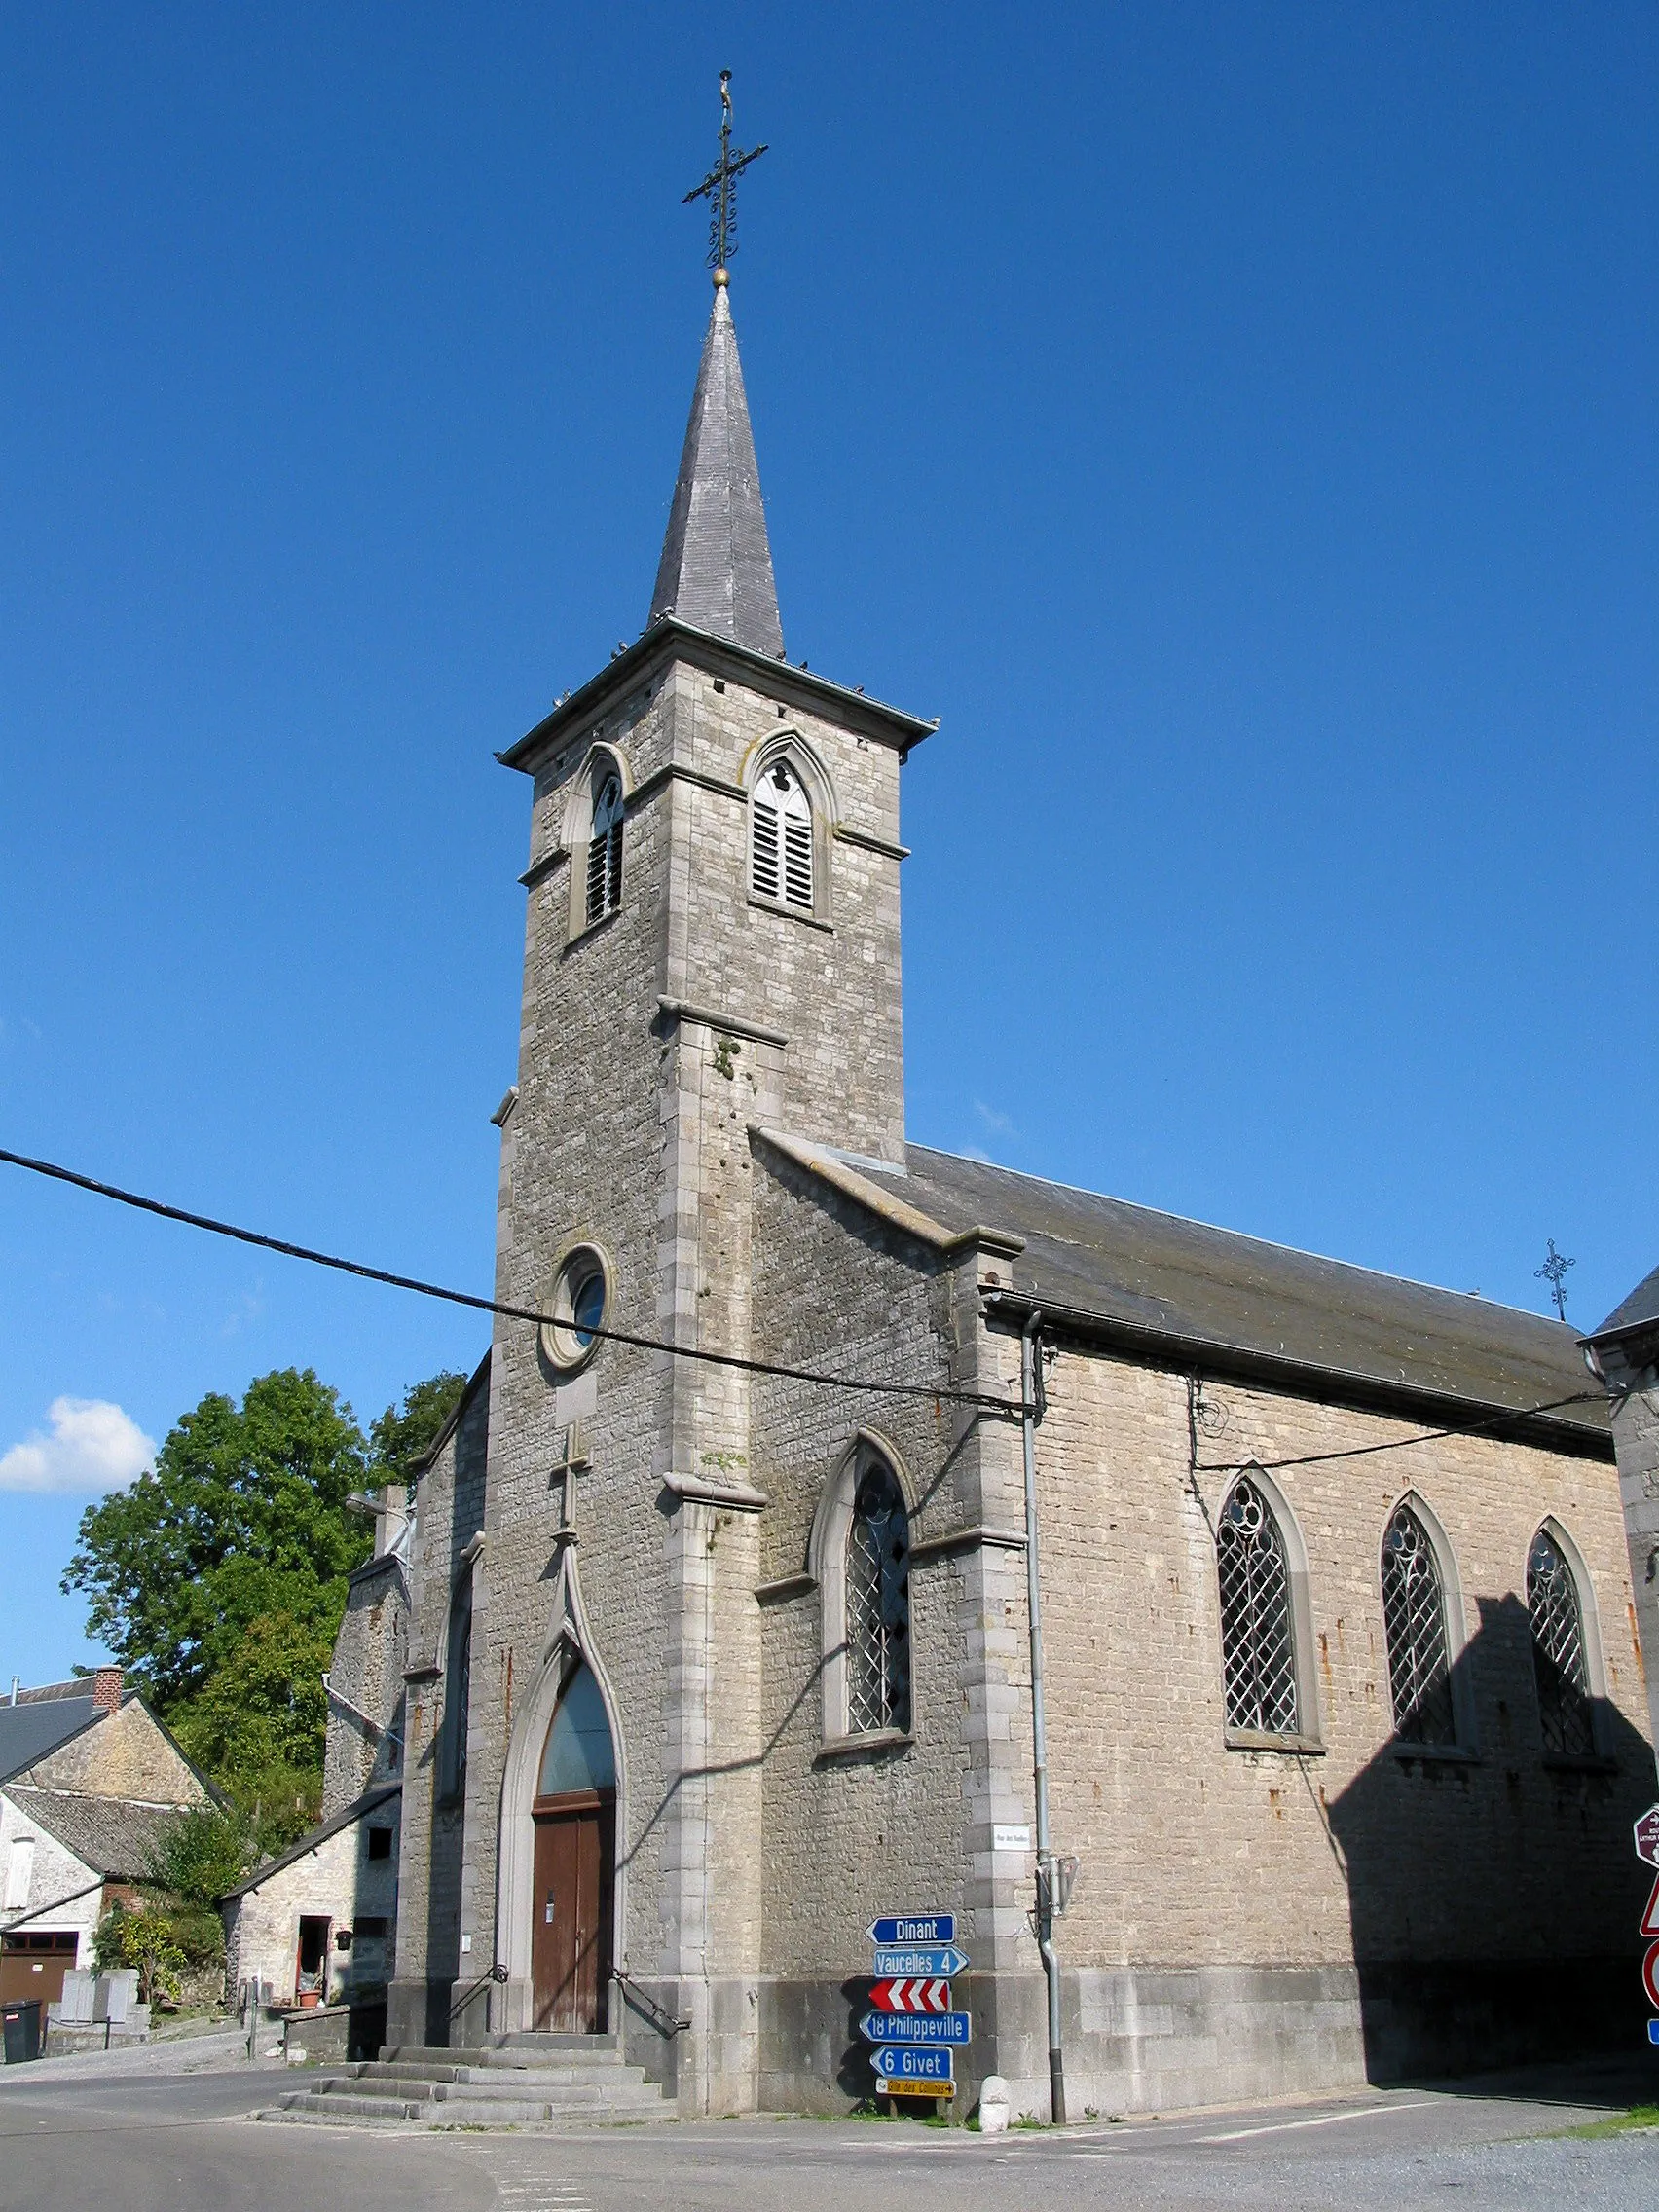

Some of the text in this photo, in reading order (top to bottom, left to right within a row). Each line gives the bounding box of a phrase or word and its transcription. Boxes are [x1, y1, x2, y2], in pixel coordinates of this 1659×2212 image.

[896, 1919, 939, 1940] Dinant
[877, 1951, 950, 1973] Vaucelles 4
[871, 2014, 963, 2041] 18 Philippeville
[885, 2051, 940, 2074] 6 Givet
